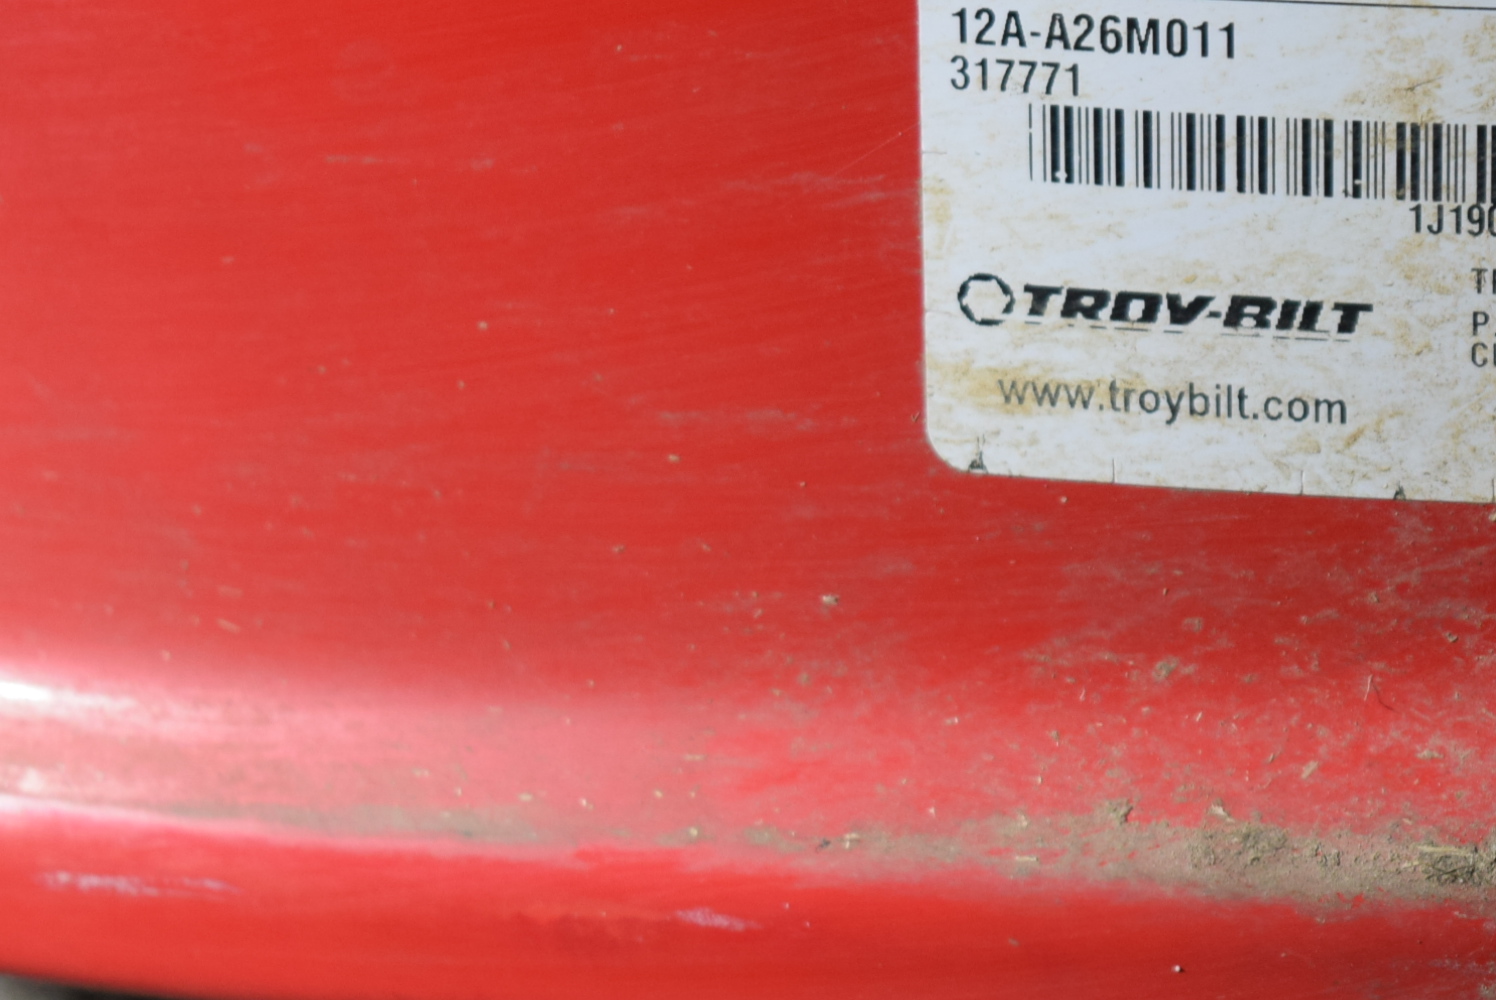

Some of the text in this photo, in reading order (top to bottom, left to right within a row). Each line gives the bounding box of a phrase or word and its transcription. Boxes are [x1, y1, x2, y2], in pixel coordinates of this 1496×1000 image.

[951, 7, 1237, 60] 12A-A26M011
[950, 55, 1081, 97] 317771
[1023, 284, 1374, 334] TROY-BILT
[997, 378, 1348, 425] www.troybilt.com
